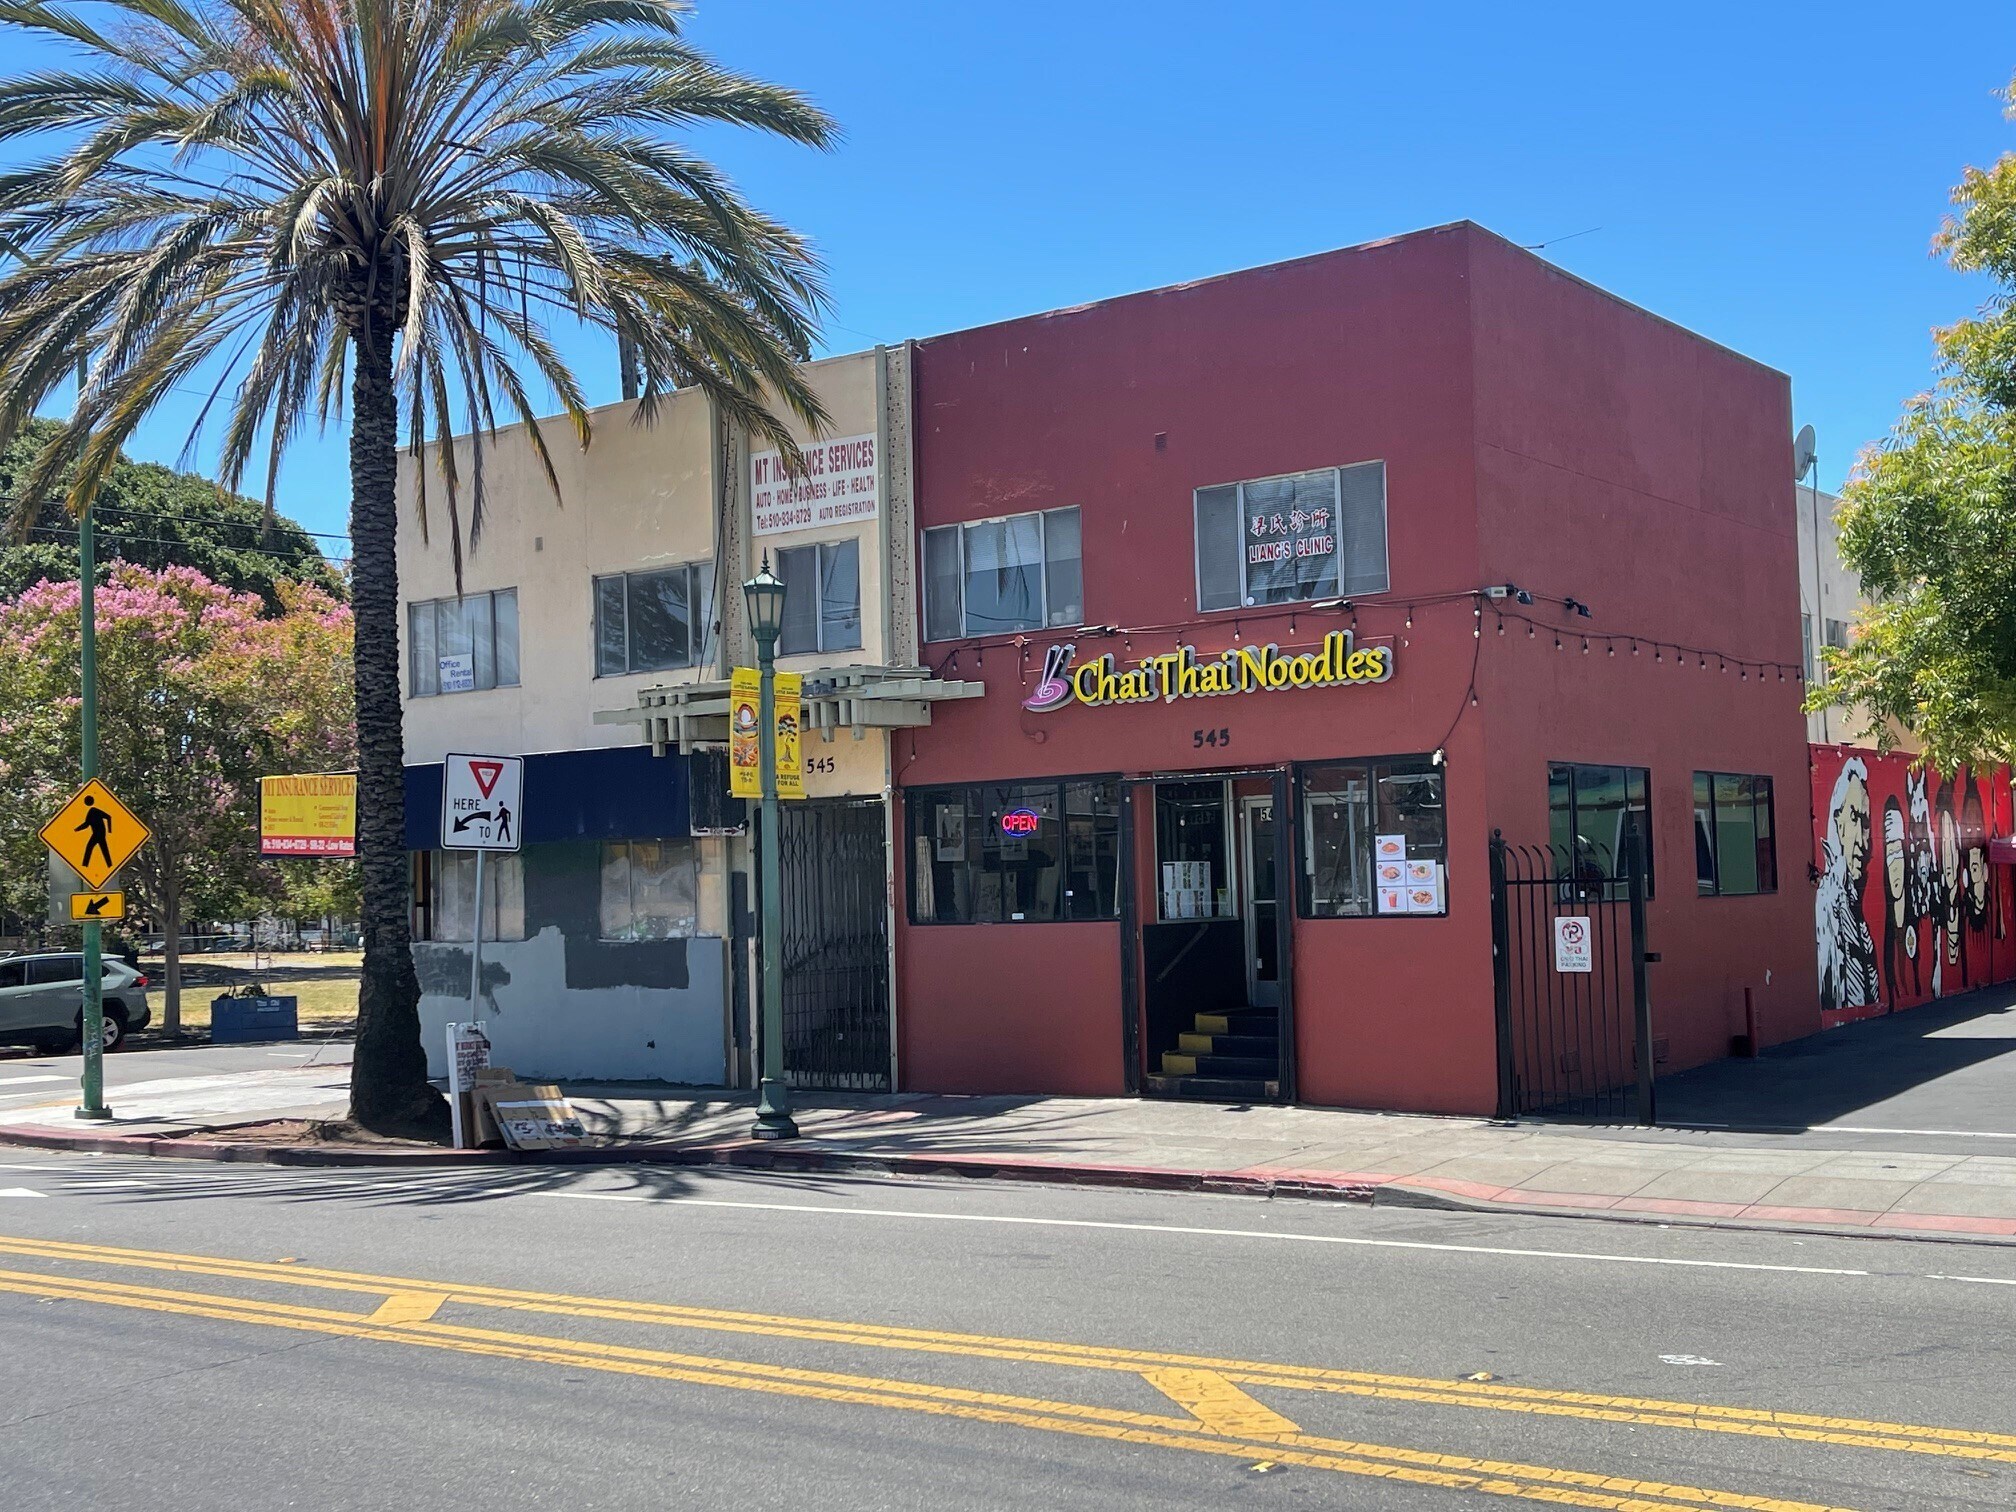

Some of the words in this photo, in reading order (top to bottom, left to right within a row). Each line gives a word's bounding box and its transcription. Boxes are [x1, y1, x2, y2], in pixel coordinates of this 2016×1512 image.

[755, 457, 769, 486] MT
[773, 449, 824, 483] INSNCE
[828, 439, 874, 474] SERVICES
[756, 491, 772, 509] AUTO
[776, 487, 793, 506] HOME
[832, 479, 846, 497] LIFE
[851, 474, 875, 495] HEALTH
[819, 506, 833, 521] AUTO
[834, 500, 876, 518] REGISTRATION
[1249, 541, 1291, 564] LIANG'S
[1296, 535, 1334, 557] CLINIC
[440, 660, 460, 670] Office
[450, 667, 472, 678] Rental
[1073, 655, 1152, 703] Chai
[1155, 645, 1233, 698] Thai
[1236, 630, 1388, 692] Noodles
[1193, 728, 1231, 749] 545
[806, 756, 835, 774] 545
[276, 777, 319, 797] INSURANCE
[320, 777, 355, 797] SERVICES
[453, 798, 481, 811] HERE
[479, 826, 491, 839] TO
[1001, 814, 1038, 832] OPEN
